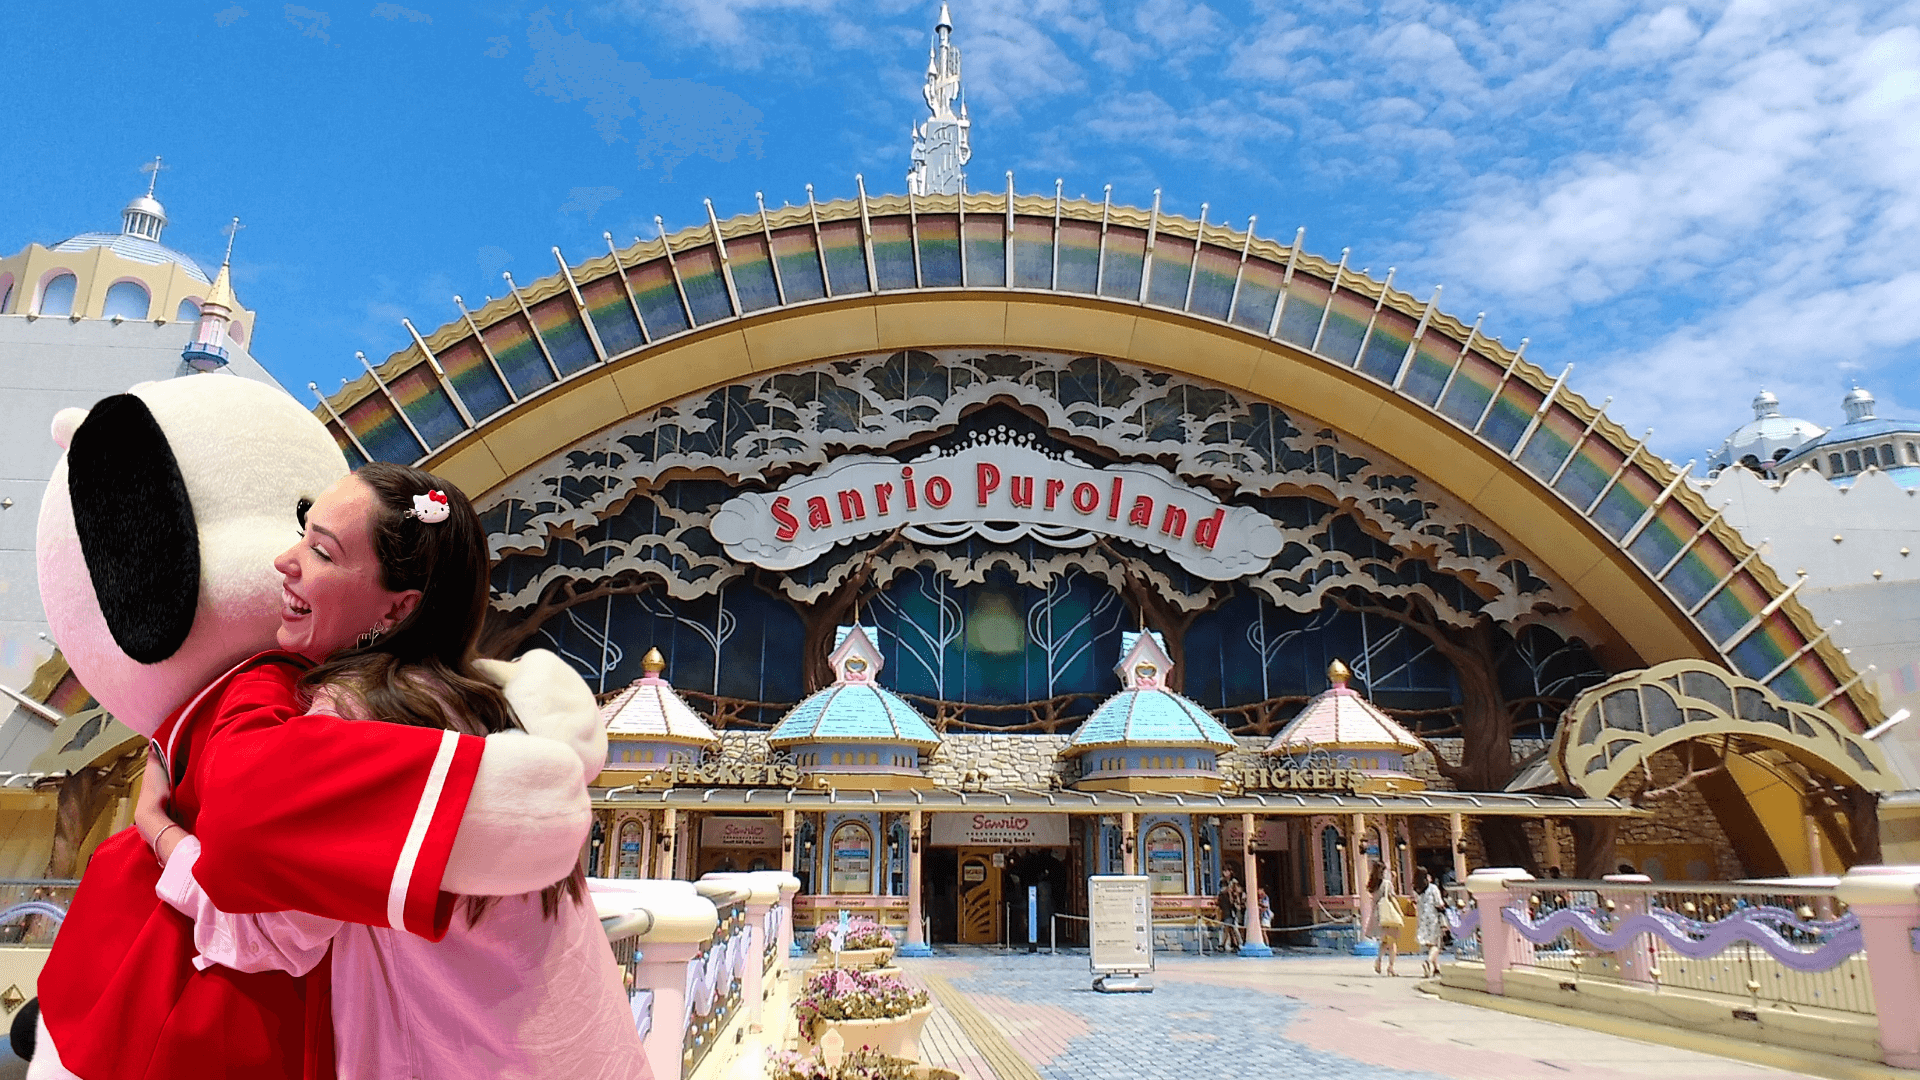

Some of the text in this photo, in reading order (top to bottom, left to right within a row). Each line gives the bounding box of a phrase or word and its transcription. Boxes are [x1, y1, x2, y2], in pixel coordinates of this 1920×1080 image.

[770, 462, 1226, 551] Sanrio Puroland
[669, 763, 800, 786] TICKETS
[1241, 768, 1364, 790] TICKETS
[972, 814, 1029, 830] Sanrio
